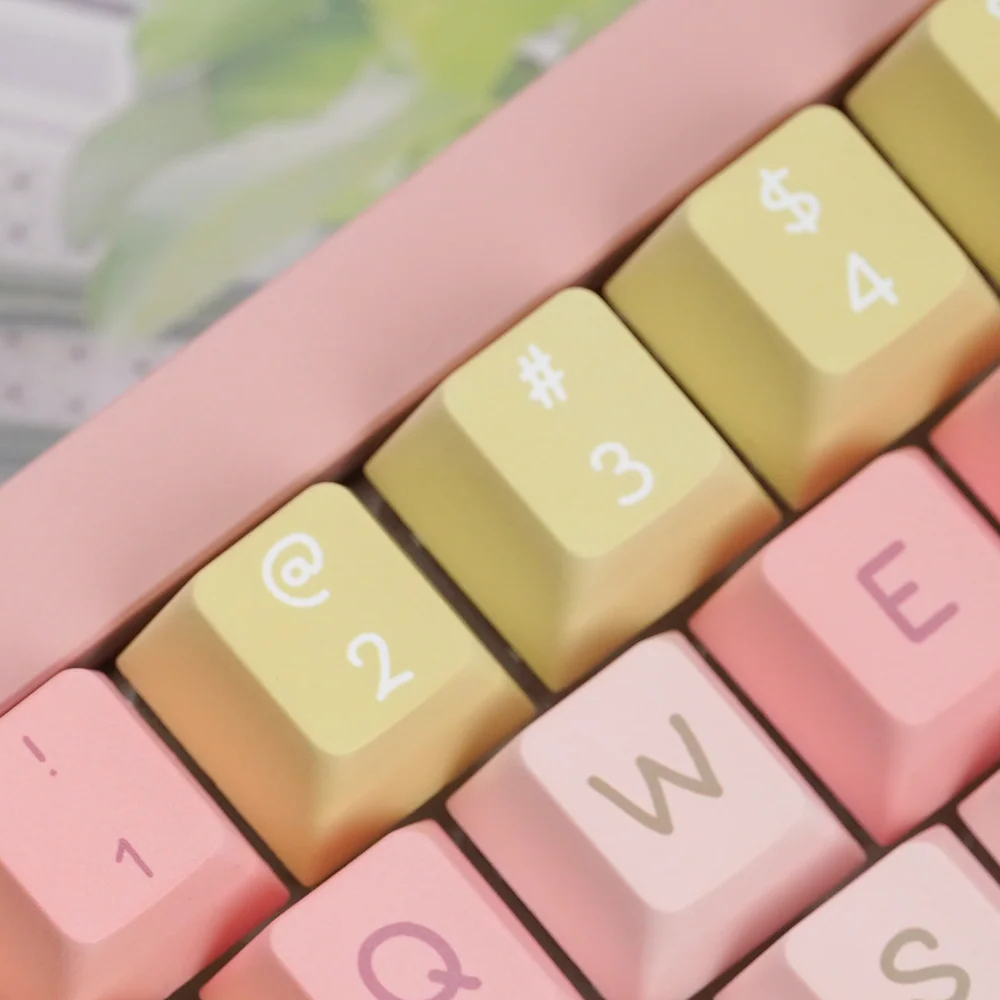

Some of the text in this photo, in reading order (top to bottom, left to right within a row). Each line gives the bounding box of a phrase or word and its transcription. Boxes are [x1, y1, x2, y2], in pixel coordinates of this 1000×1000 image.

[846, 251, 898, 313] 4
[589, 441, 655, 507] 3
[261, 532, 331, 608] @
[855, 539, 960, 644] E
[346, 632, 415, 702] 2
[587, 712, 724, 836] W
[115, 837, 155, 879] 1
